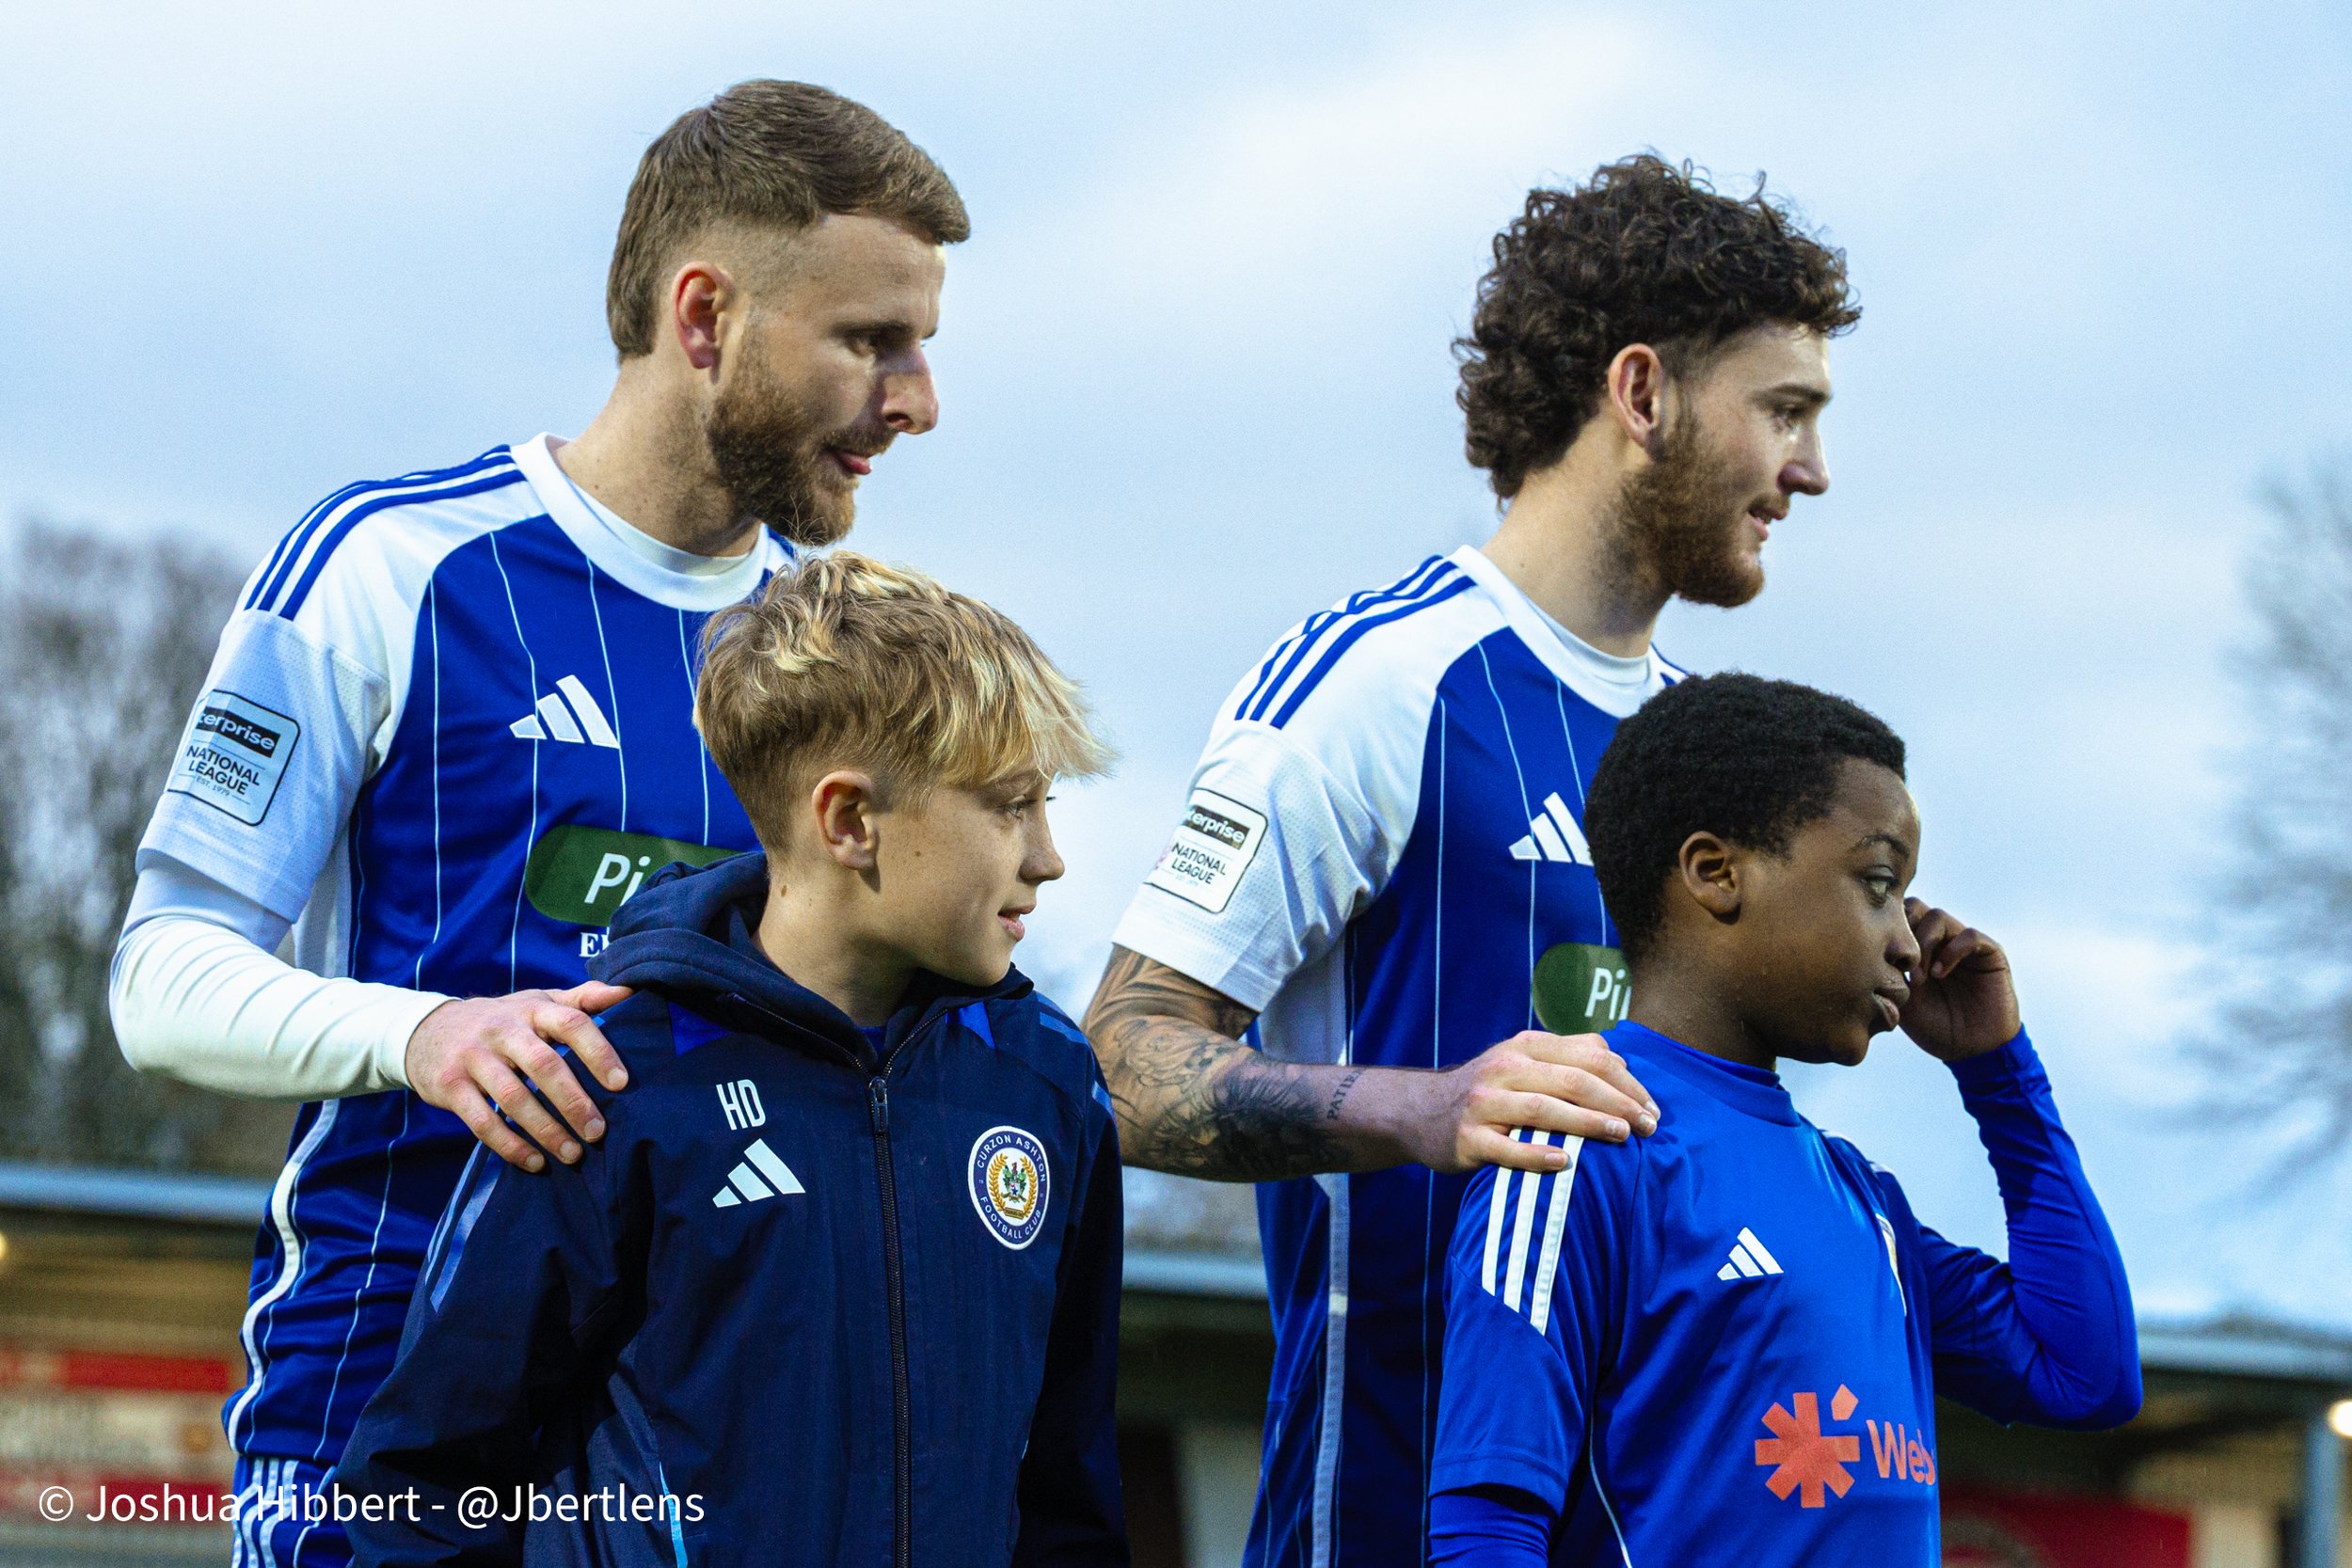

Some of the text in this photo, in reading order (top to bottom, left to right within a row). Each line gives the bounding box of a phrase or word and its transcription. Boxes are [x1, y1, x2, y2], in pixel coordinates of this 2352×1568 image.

[186, 745, 261, 786] NATIONAL
[189, 760, 249, 796] LEAGUE
[1187, 810, 1246, 843] erprise
[1171, 842, 1227, 876] NATIONAL
[1171, 858, 1216, 885] LEAGUE
[716, 1079, 767, 1131] HD
[977, 1134, 1046, 1182] CURZON ASHTON
[980, 1196, 1041, 1239] FOOTBALL CLUB
[1866, 1419, 1935, 1485] Web
